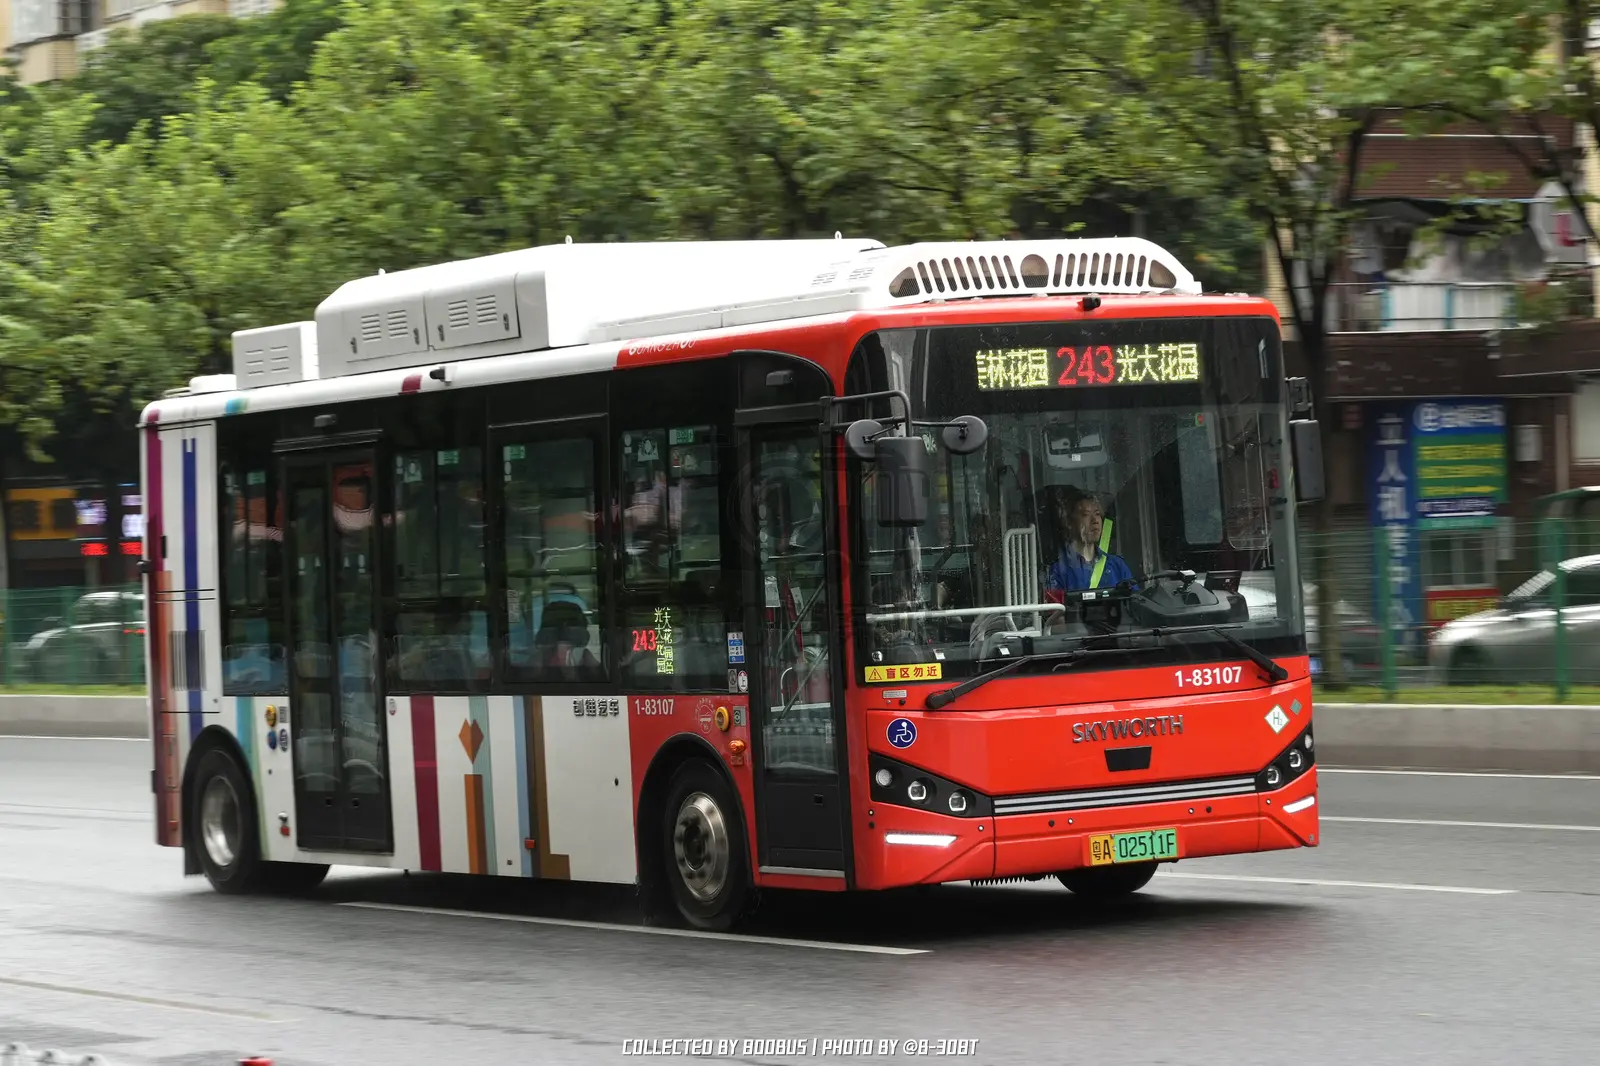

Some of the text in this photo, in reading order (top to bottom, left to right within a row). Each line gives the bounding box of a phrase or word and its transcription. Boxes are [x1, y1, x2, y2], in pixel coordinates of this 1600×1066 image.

[1056, 345, 1116, 386] 243
[1117, 342, 1199, 383] 光大花园
[631, 630, 656, 652] 243
[885, 665, 938, 680] 盲区勿近
[1174, 665, 1243, 688] 1-83107
[573, 698, 620, 717] 创维汽车
[634, 698, 675, 716] 1-83107
[1072, 714, 1184, 744] SKYWORTH
[1118, 832, 1175, 859] 02511F
